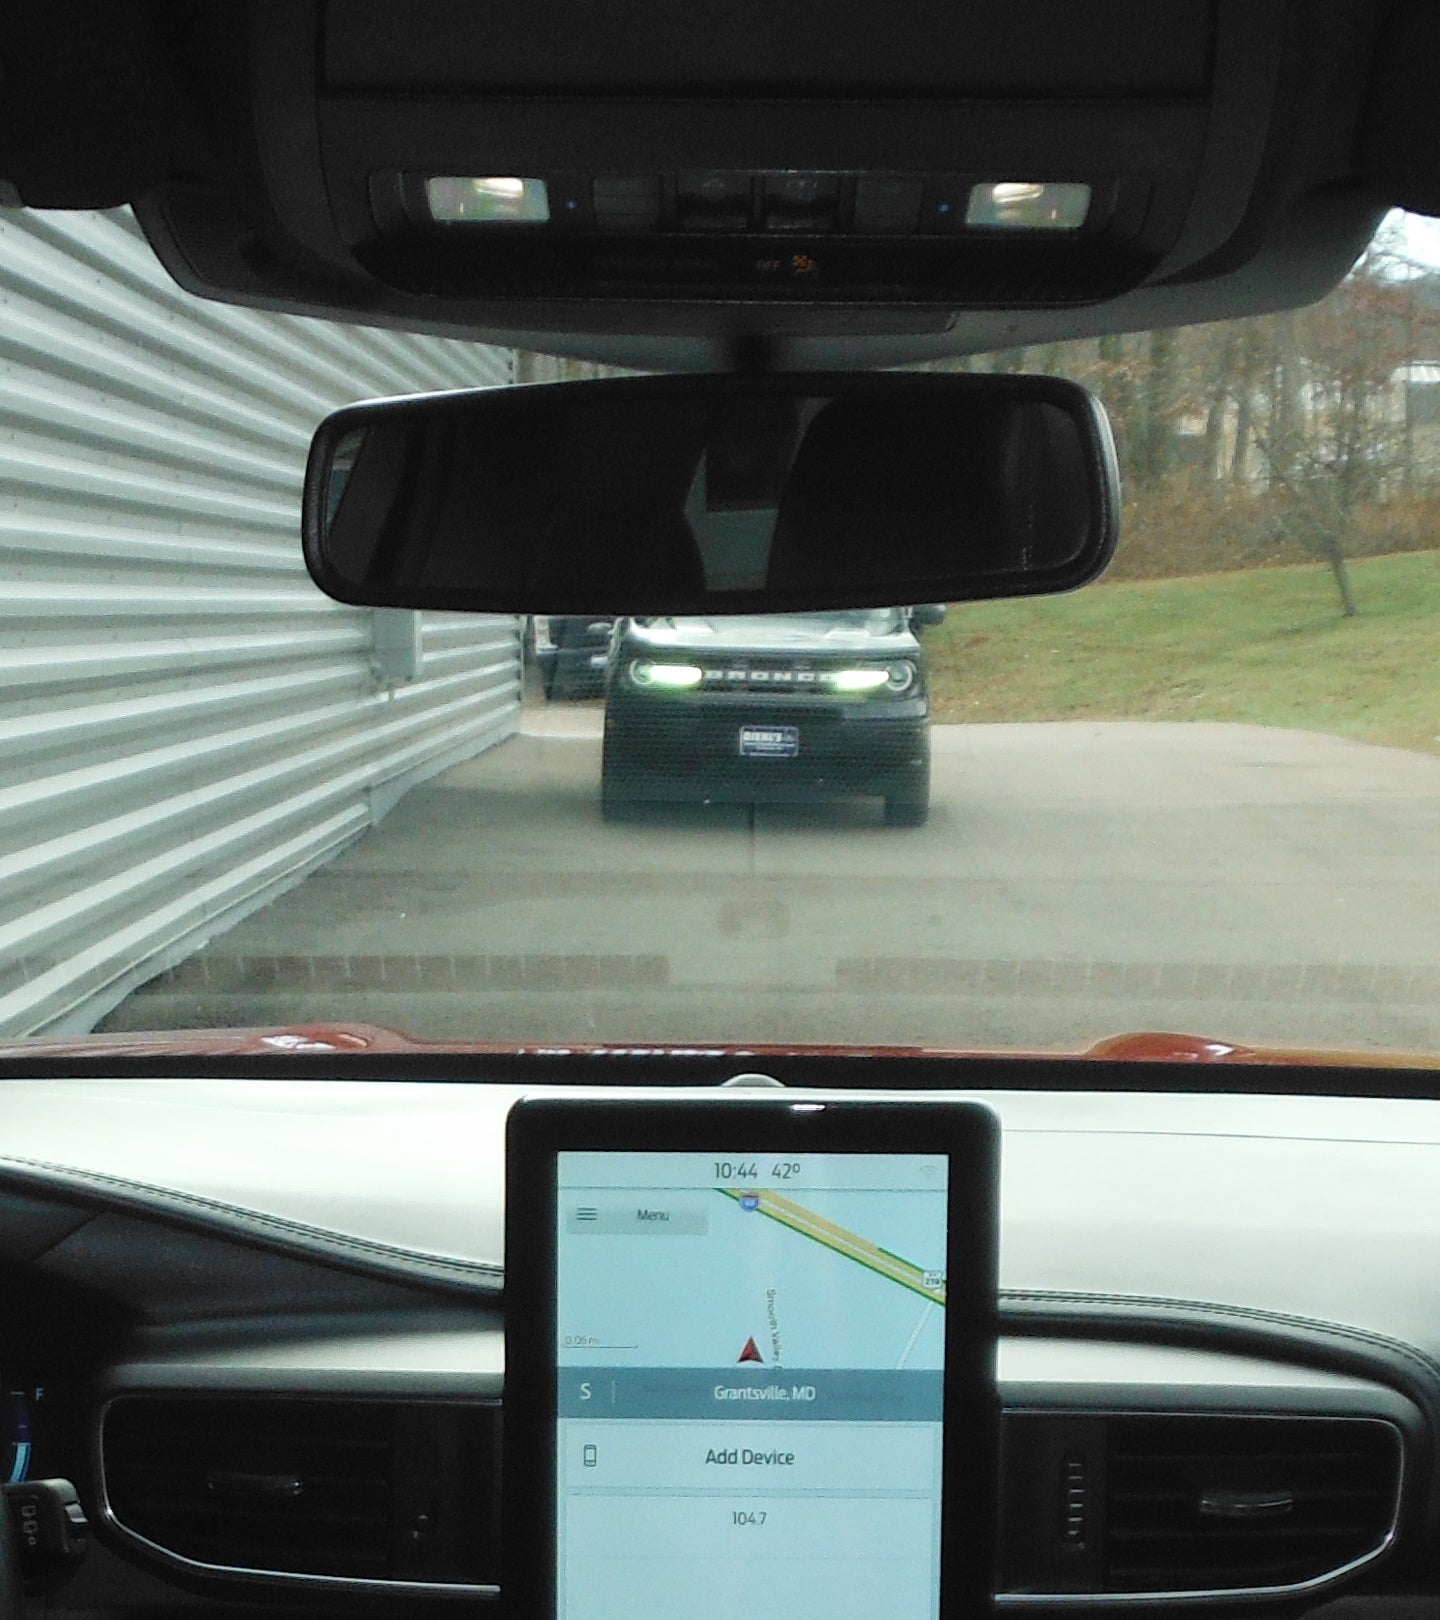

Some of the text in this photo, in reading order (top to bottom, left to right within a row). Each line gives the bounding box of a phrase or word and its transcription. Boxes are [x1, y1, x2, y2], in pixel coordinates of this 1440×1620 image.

[714, 1162, 758, 1179] 10:44
[637, 1208, 670, 1222] Menu
[35, 1387, 45, 1401] F
[579, 1383, 592, 1400] S
[713, 1384, 817, 1402] Grantsville, MD
[705, 1448, 795, 1466] Add Device
[732, 1511, 767, 1527] 104.7
